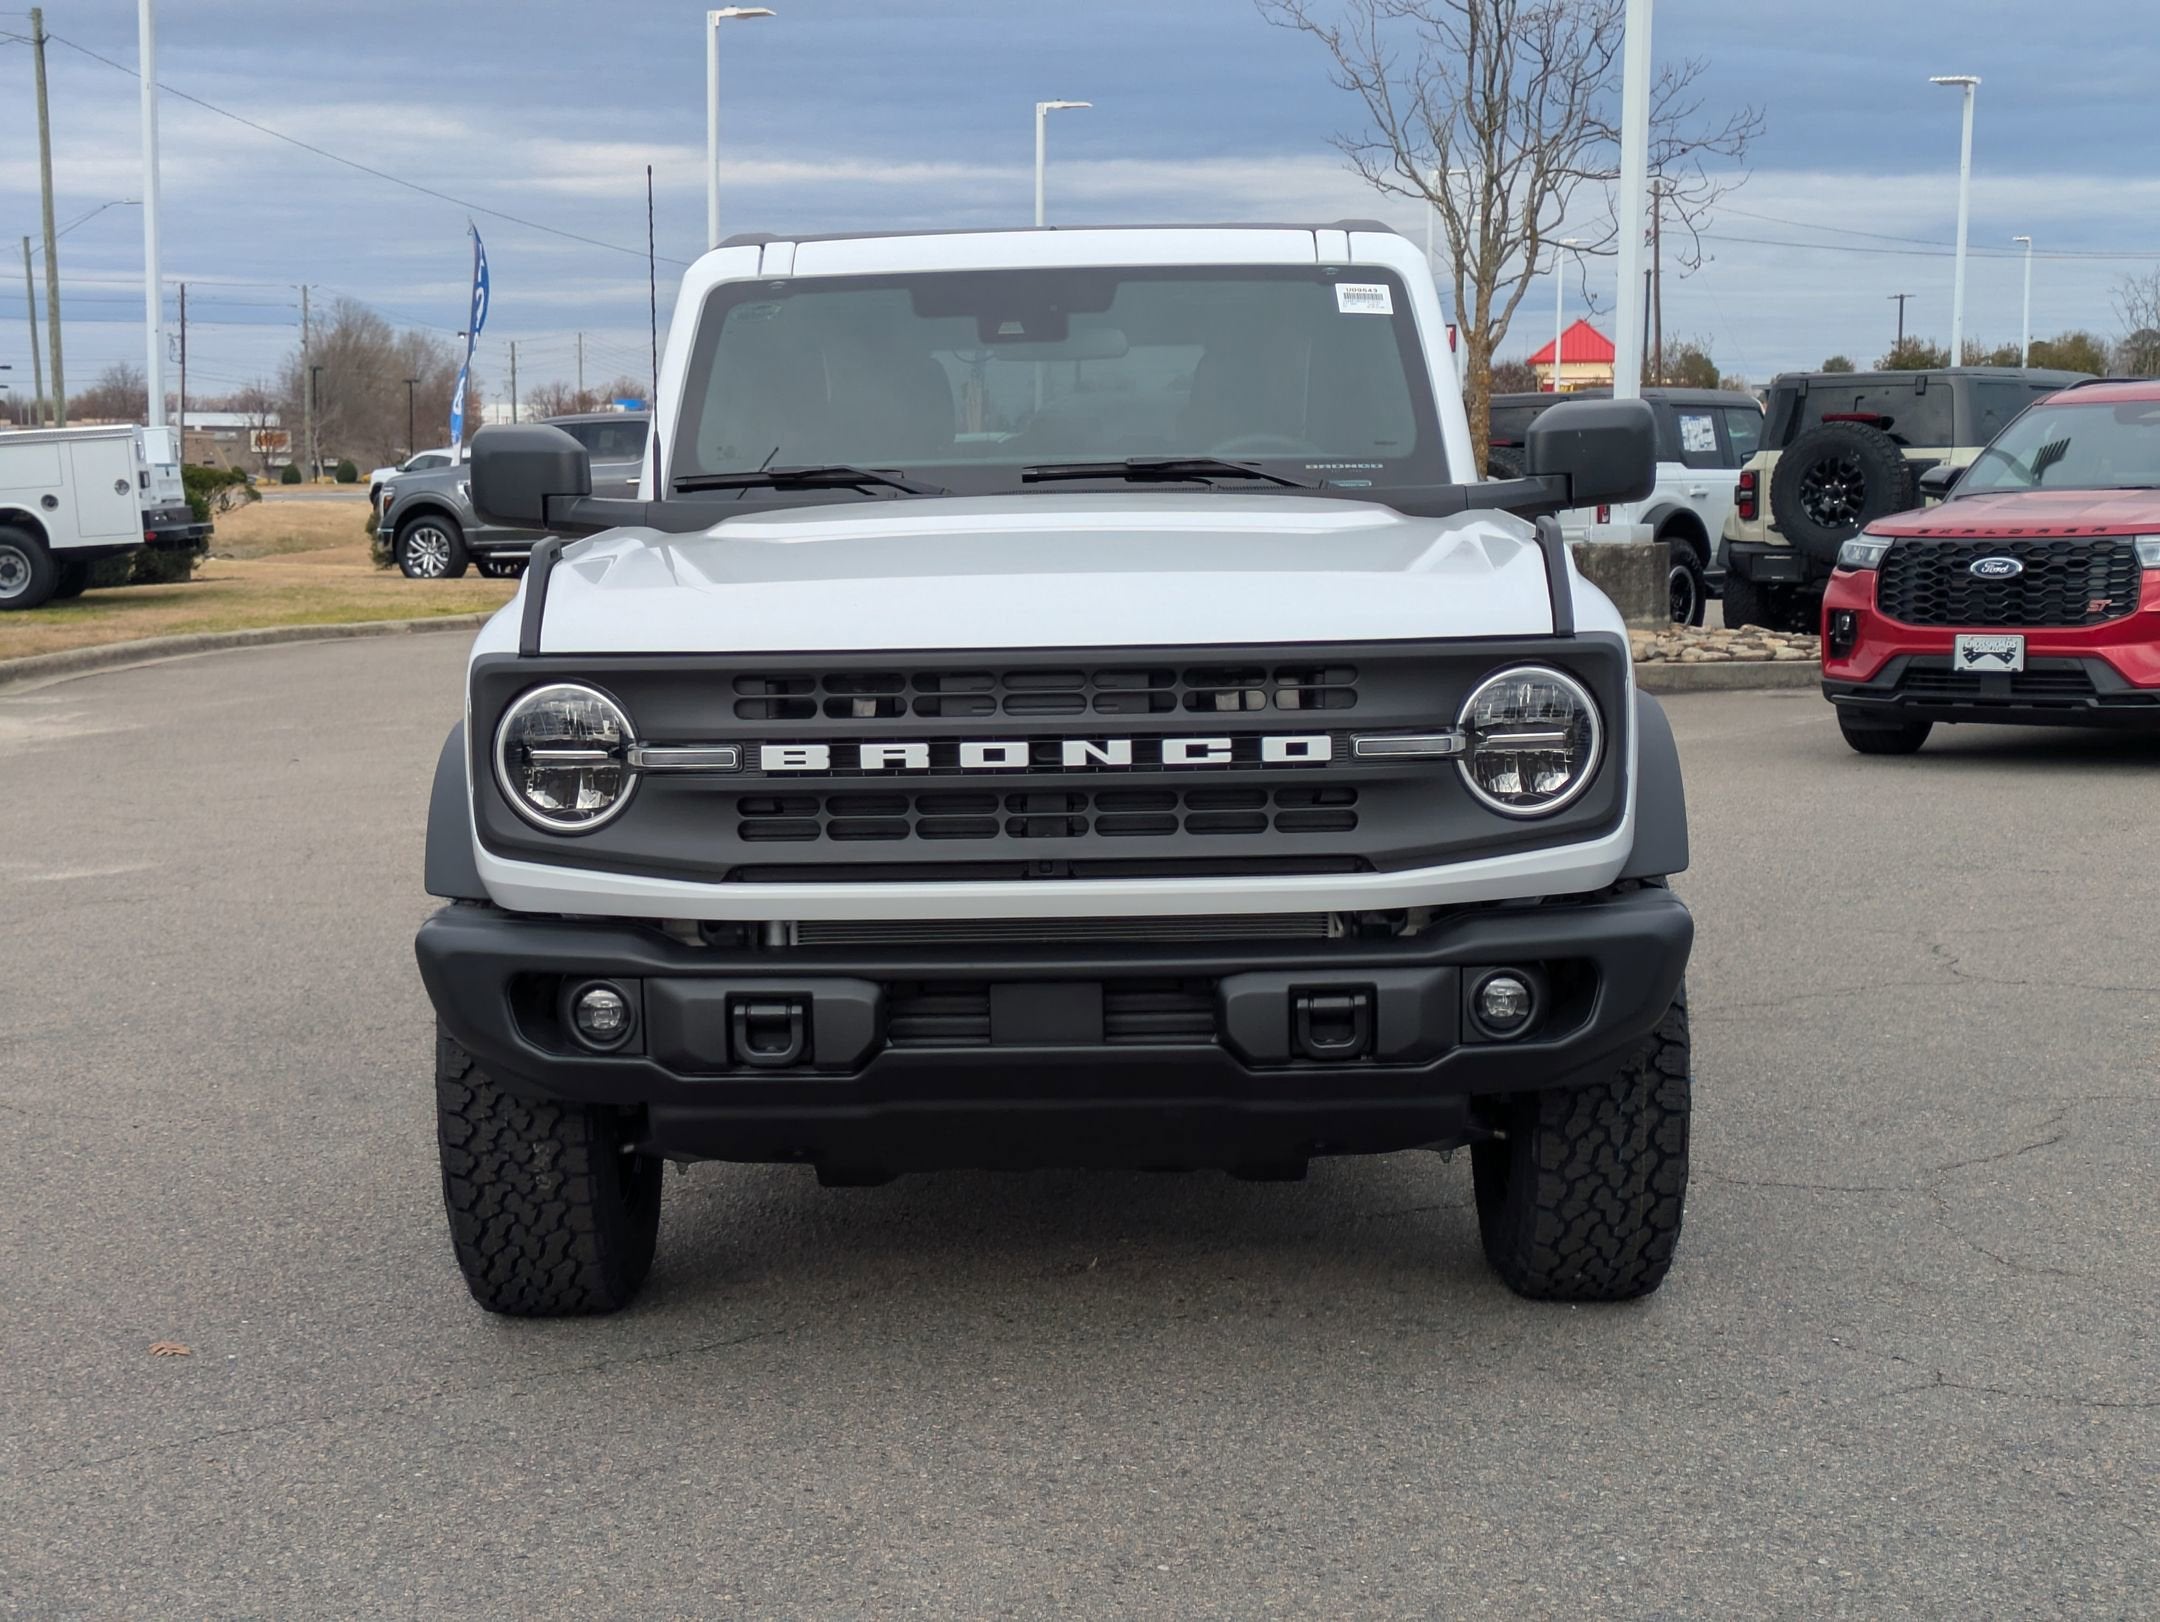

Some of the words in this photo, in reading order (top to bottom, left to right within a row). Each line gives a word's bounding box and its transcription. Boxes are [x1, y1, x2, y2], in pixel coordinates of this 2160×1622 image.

[1981, 561, 2009, 574] Ford
[2086, 599, 2112, 612] ST
[760, 736, 1332, 771] BRONCO
